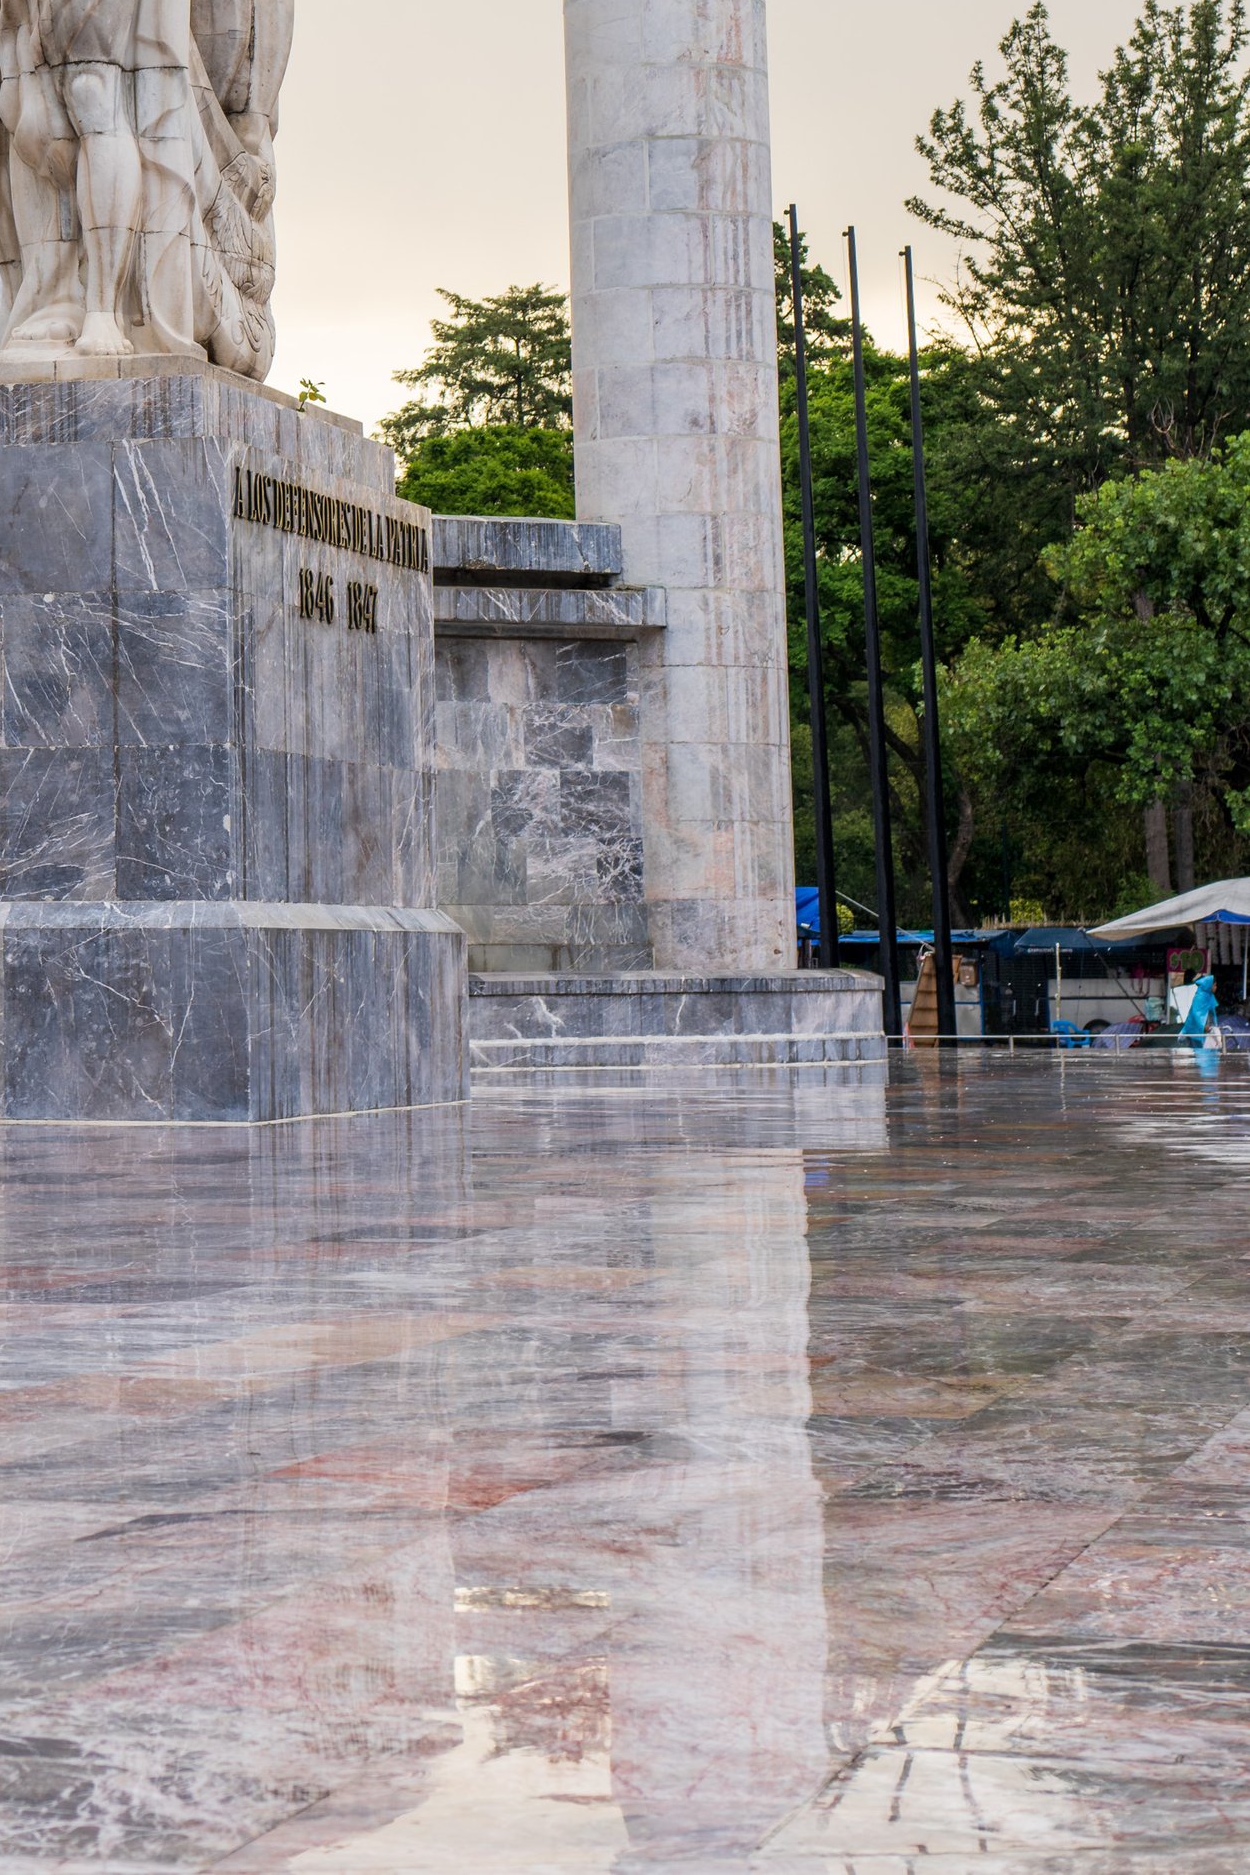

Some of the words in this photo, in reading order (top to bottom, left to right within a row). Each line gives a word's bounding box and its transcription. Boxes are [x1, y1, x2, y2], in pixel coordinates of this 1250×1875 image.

[235, 466, 244, 518] A
[247, 469, 271, 525] LOS
[273, 479, 350, 550] DEFENSORES
[351, 505, 367, 555] DE
[368, 509, 384, 561] LA
[386, 516, 430, 574] PATRIA
[299, 568, 334, 625] 1846
[347, 581, 378, 634] 1847
